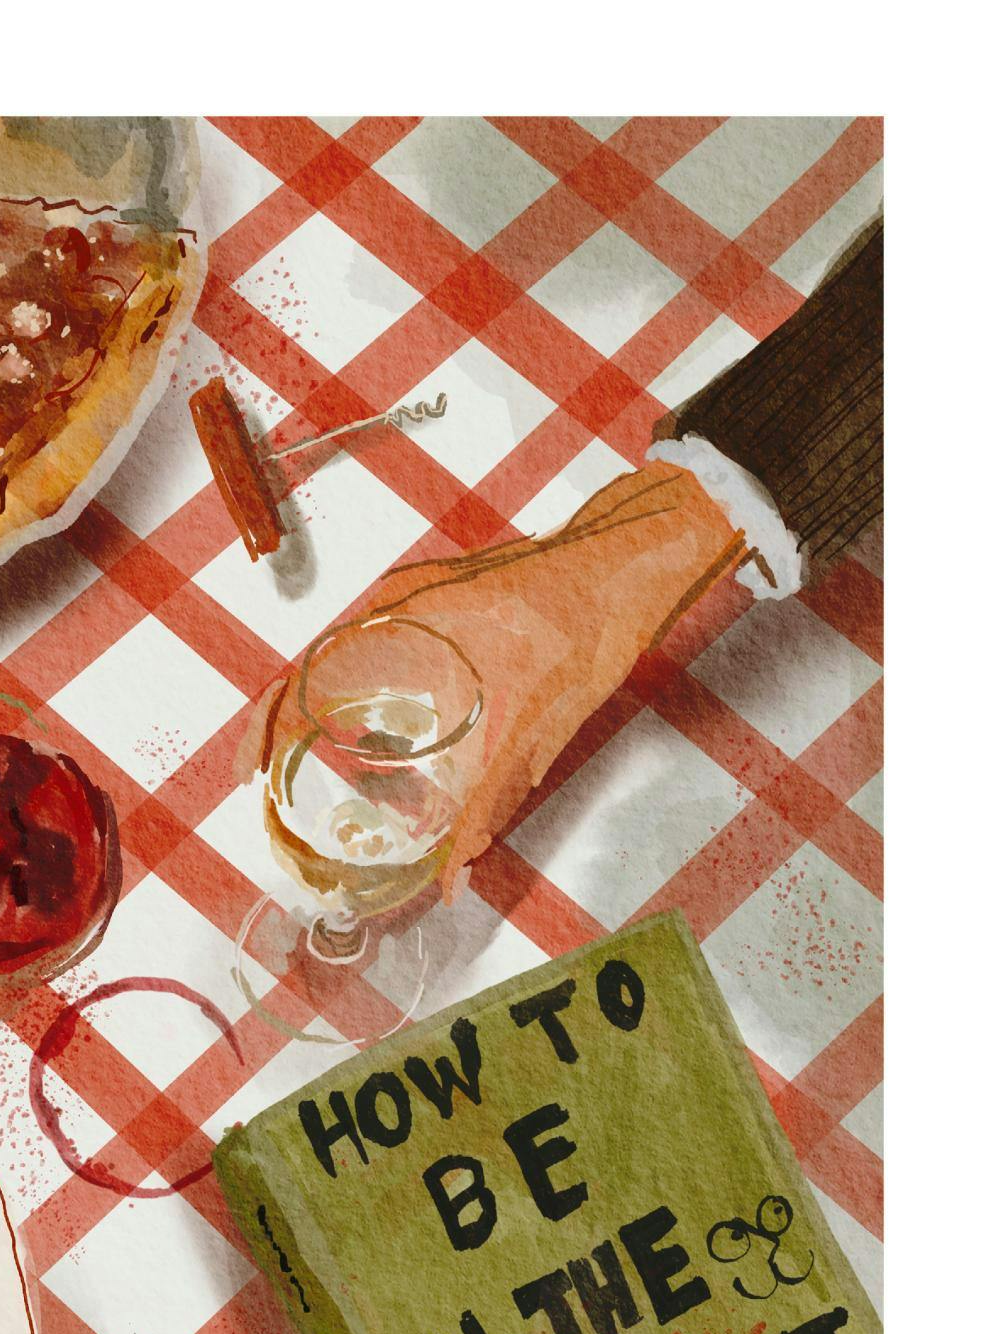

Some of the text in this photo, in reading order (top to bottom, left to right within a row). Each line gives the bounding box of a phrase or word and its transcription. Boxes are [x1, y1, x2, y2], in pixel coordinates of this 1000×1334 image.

[298, 960, 645, 1178] HOW TO
[422, 1102, 589, 1251] BE
